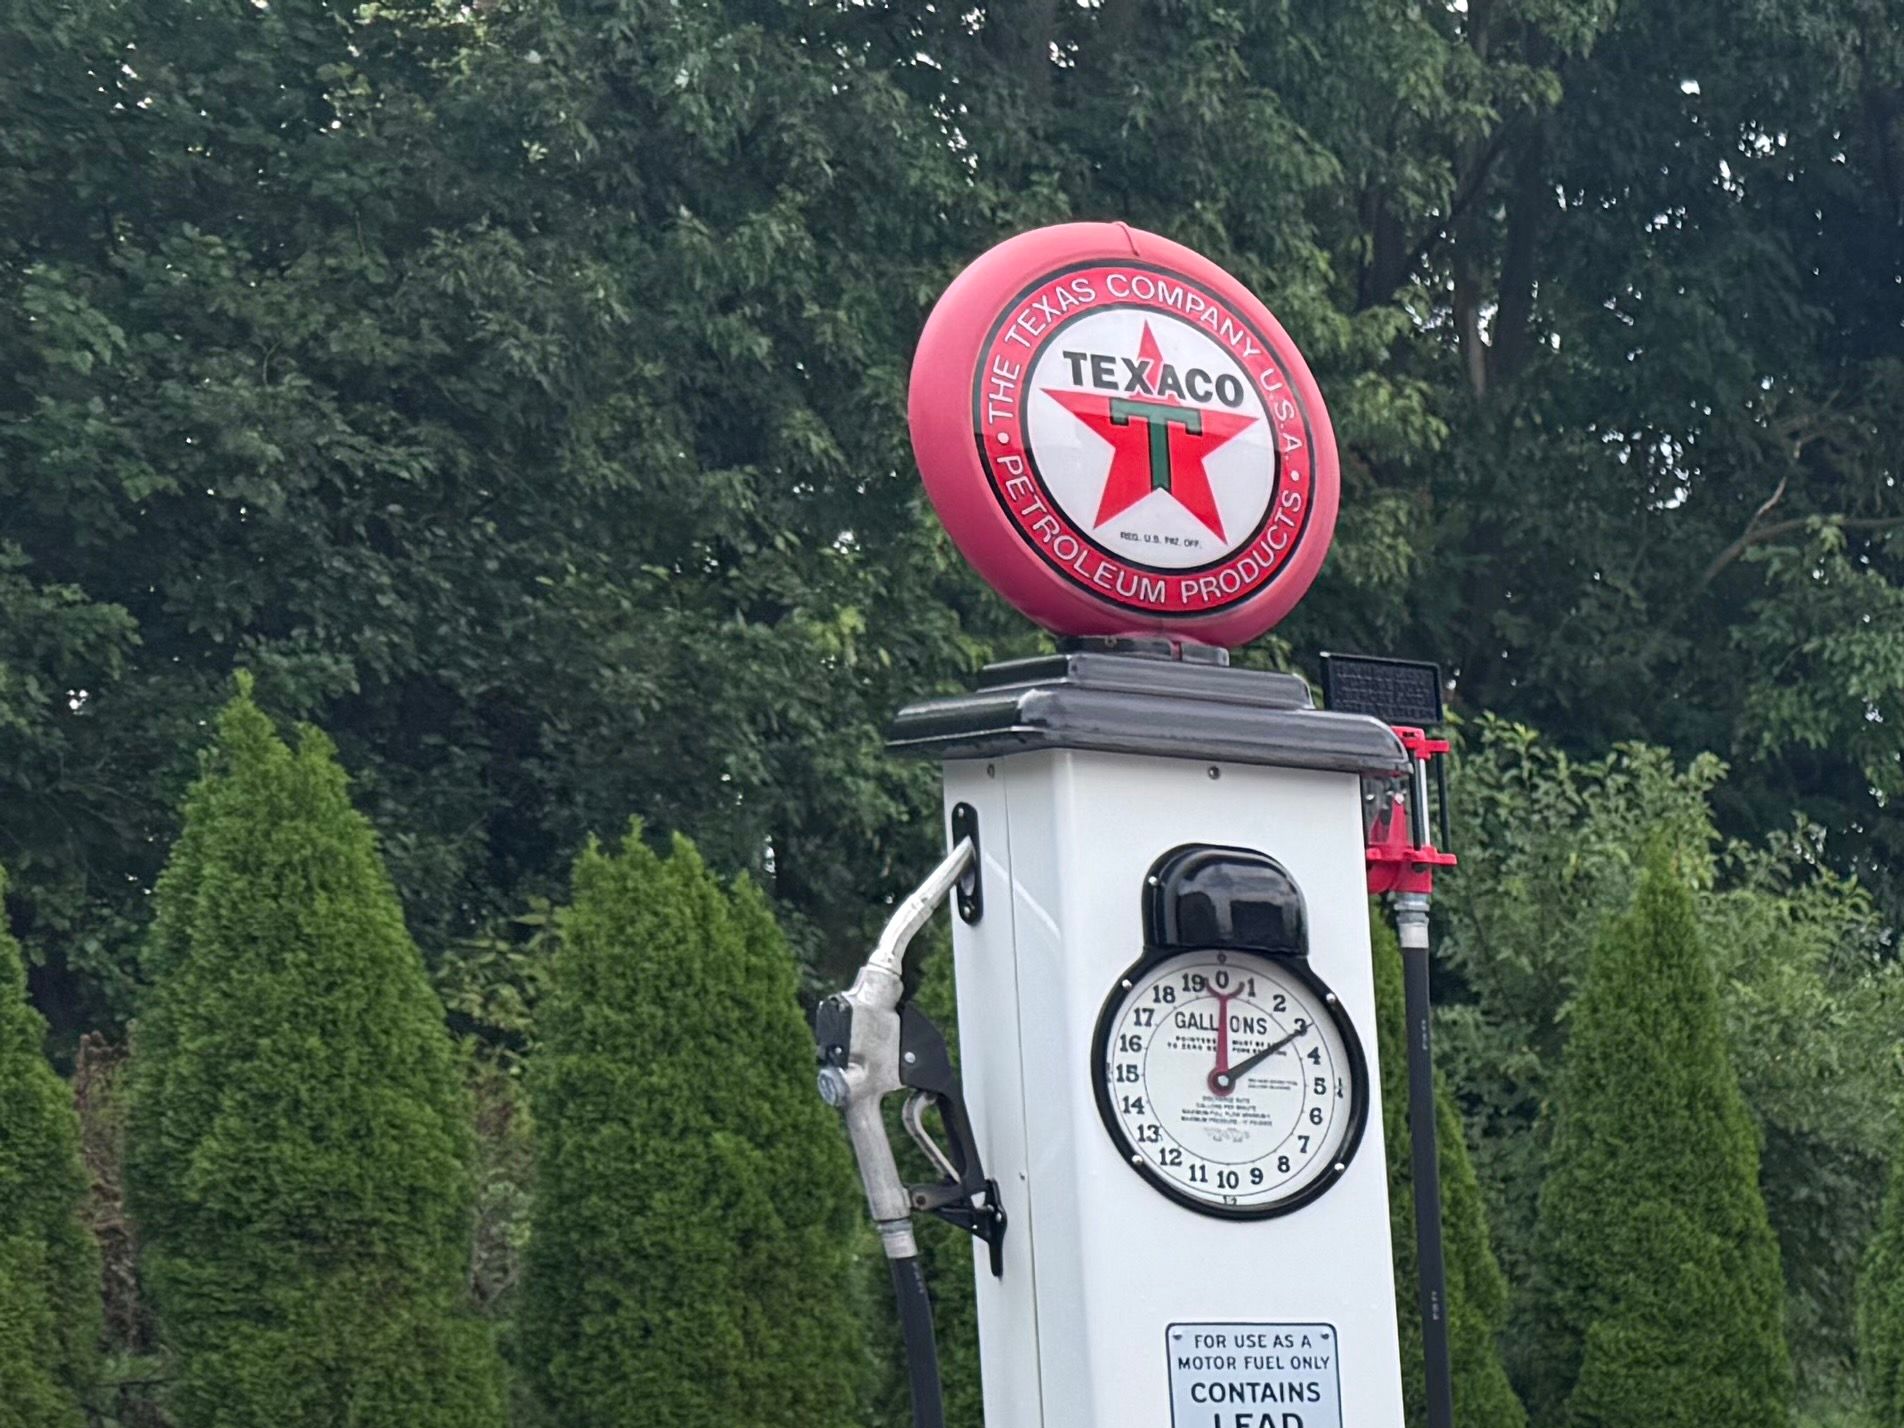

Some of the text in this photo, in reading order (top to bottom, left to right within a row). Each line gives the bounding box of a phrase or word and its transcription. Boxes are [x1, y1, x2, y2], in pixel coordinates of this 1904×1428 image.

[988, 354, 1021, 425] THE
[1005, 278, 1097, 350] TEXAS
[1106, 274, 1262, 359] COMPANY
[1062, 350, 1245, 408] TEXACO
[996, 454, 1301, 604] PETROLEUM PRODUCTS
[1182, 973, 1206, 992] 19
[1215, 969, 1230, 989] 0
[1247, 977, 1256, 997] 1
[1153, 985, 1176, 1004] 18
[1272, 994, 1287, 1013] 2
[1133, 1008, 1155, 1027] 17
[1175, 1011, 1267, 1035] GALLONS
[1294, 1018, 1308, 1036] 3
[1120, 1034, 1142, 1052] 16
[1307, 1047, 1321, 1065] 4
[1116, 1063, 1140, 1083] 15
[1313, 1077, 1327, 1095] 5
[1123, 1096, 1145, 1114] 14
[1310, 1108, 1323, 1125] 6
[1137, 1124, 1160, 1142] 13
[1298, 1135, 1311, 1154] 7
[1160, 1148, 1182, 1167] 12
[1277, 1156, 1291, 1173] 8
[1188, 1165, 1208, 1183] 11
[1217, 1170, 1239, 1190] 10
[1250, 1168, 1264, 1185] 9
[1194, 1334, 1312, 1349] FOR USE AS A
[1178, 1356, 1330, 1370] MOTOR FUEL ONLY
[1191, 1382, 1321, 1403] CONTAINS
